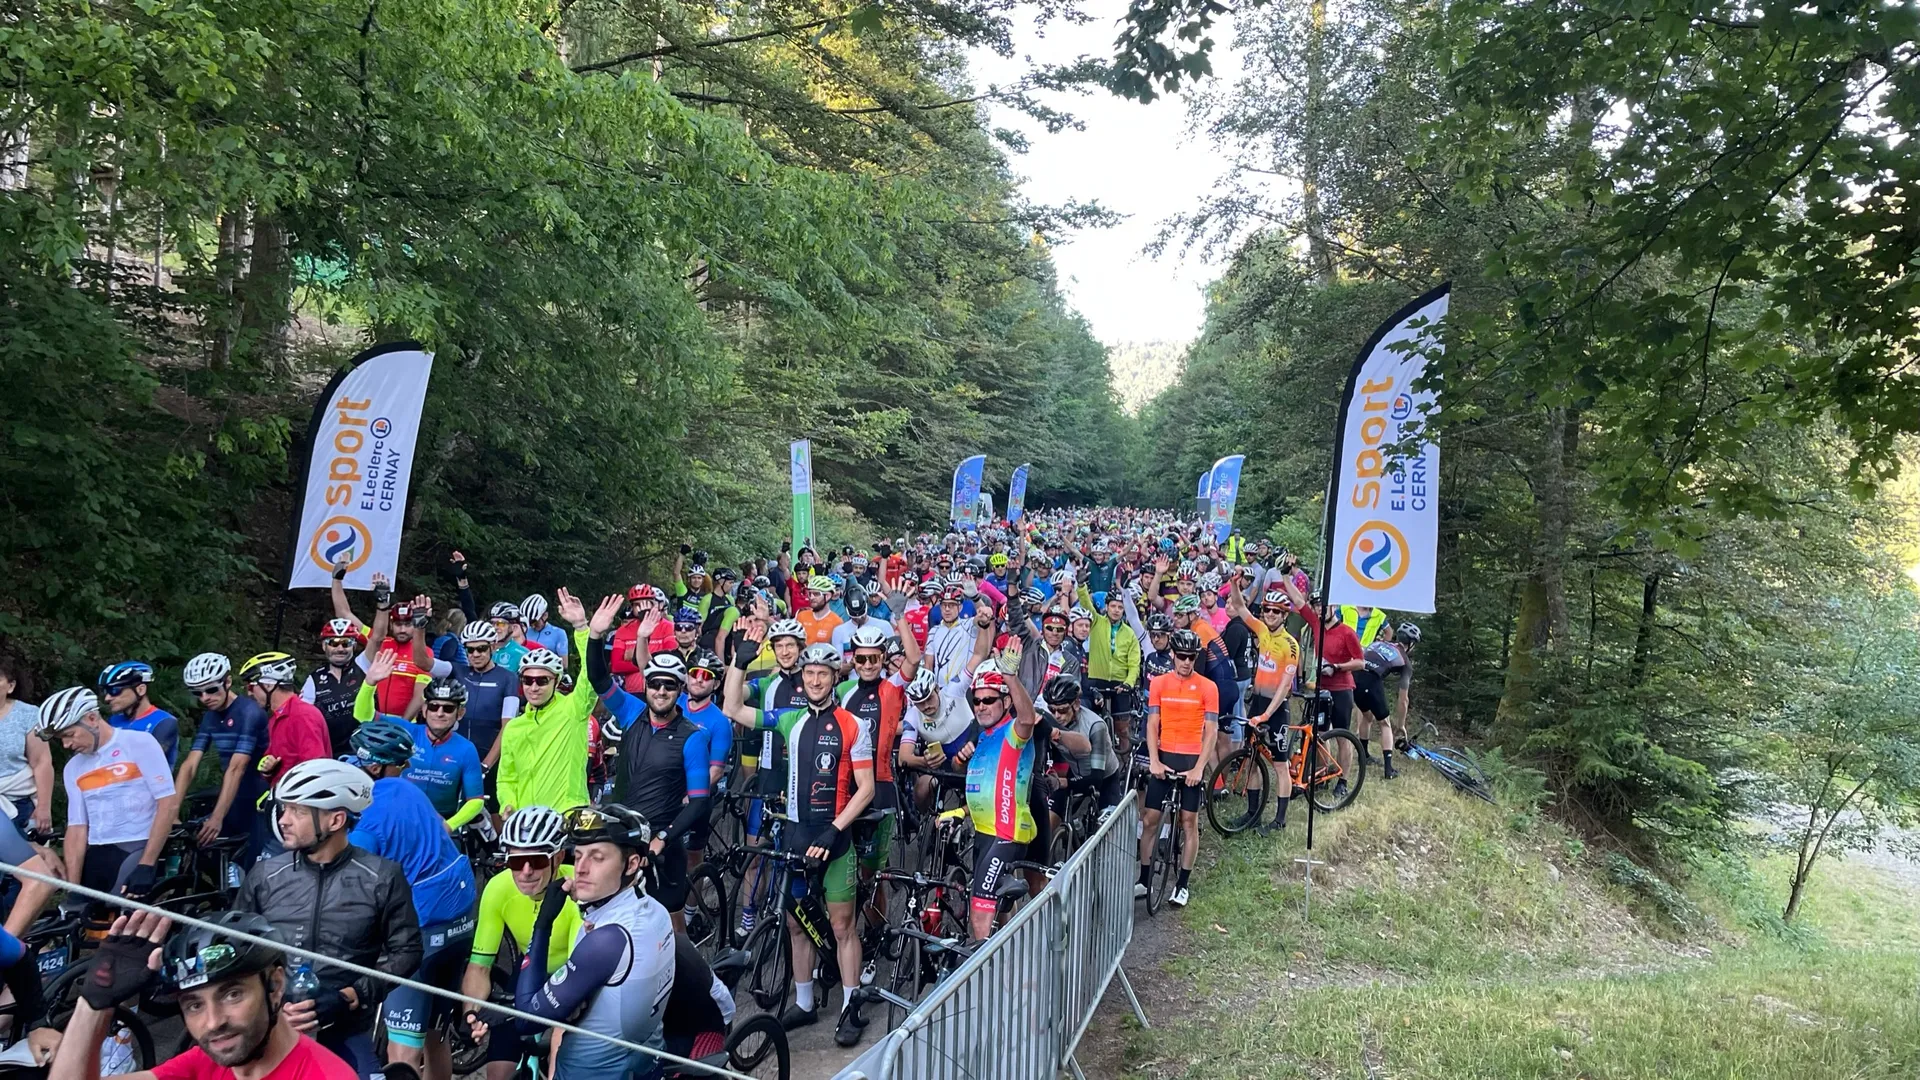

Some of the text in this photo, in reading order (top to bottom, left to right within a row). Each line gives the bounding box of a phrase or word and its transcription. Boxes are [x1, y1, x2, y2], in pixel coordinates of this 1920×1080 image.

[325, 396, 372, 508] sport
[1352, 376, 1393, 510] sport
[360, 440, 384, 511] E.Leclerc
[379, 448, 401, 512] CERNAY
[794, 904, 825, 948] CUBE
[37, 956, 64, 973] 1424
[401, 1008, 413, 1022] 3
